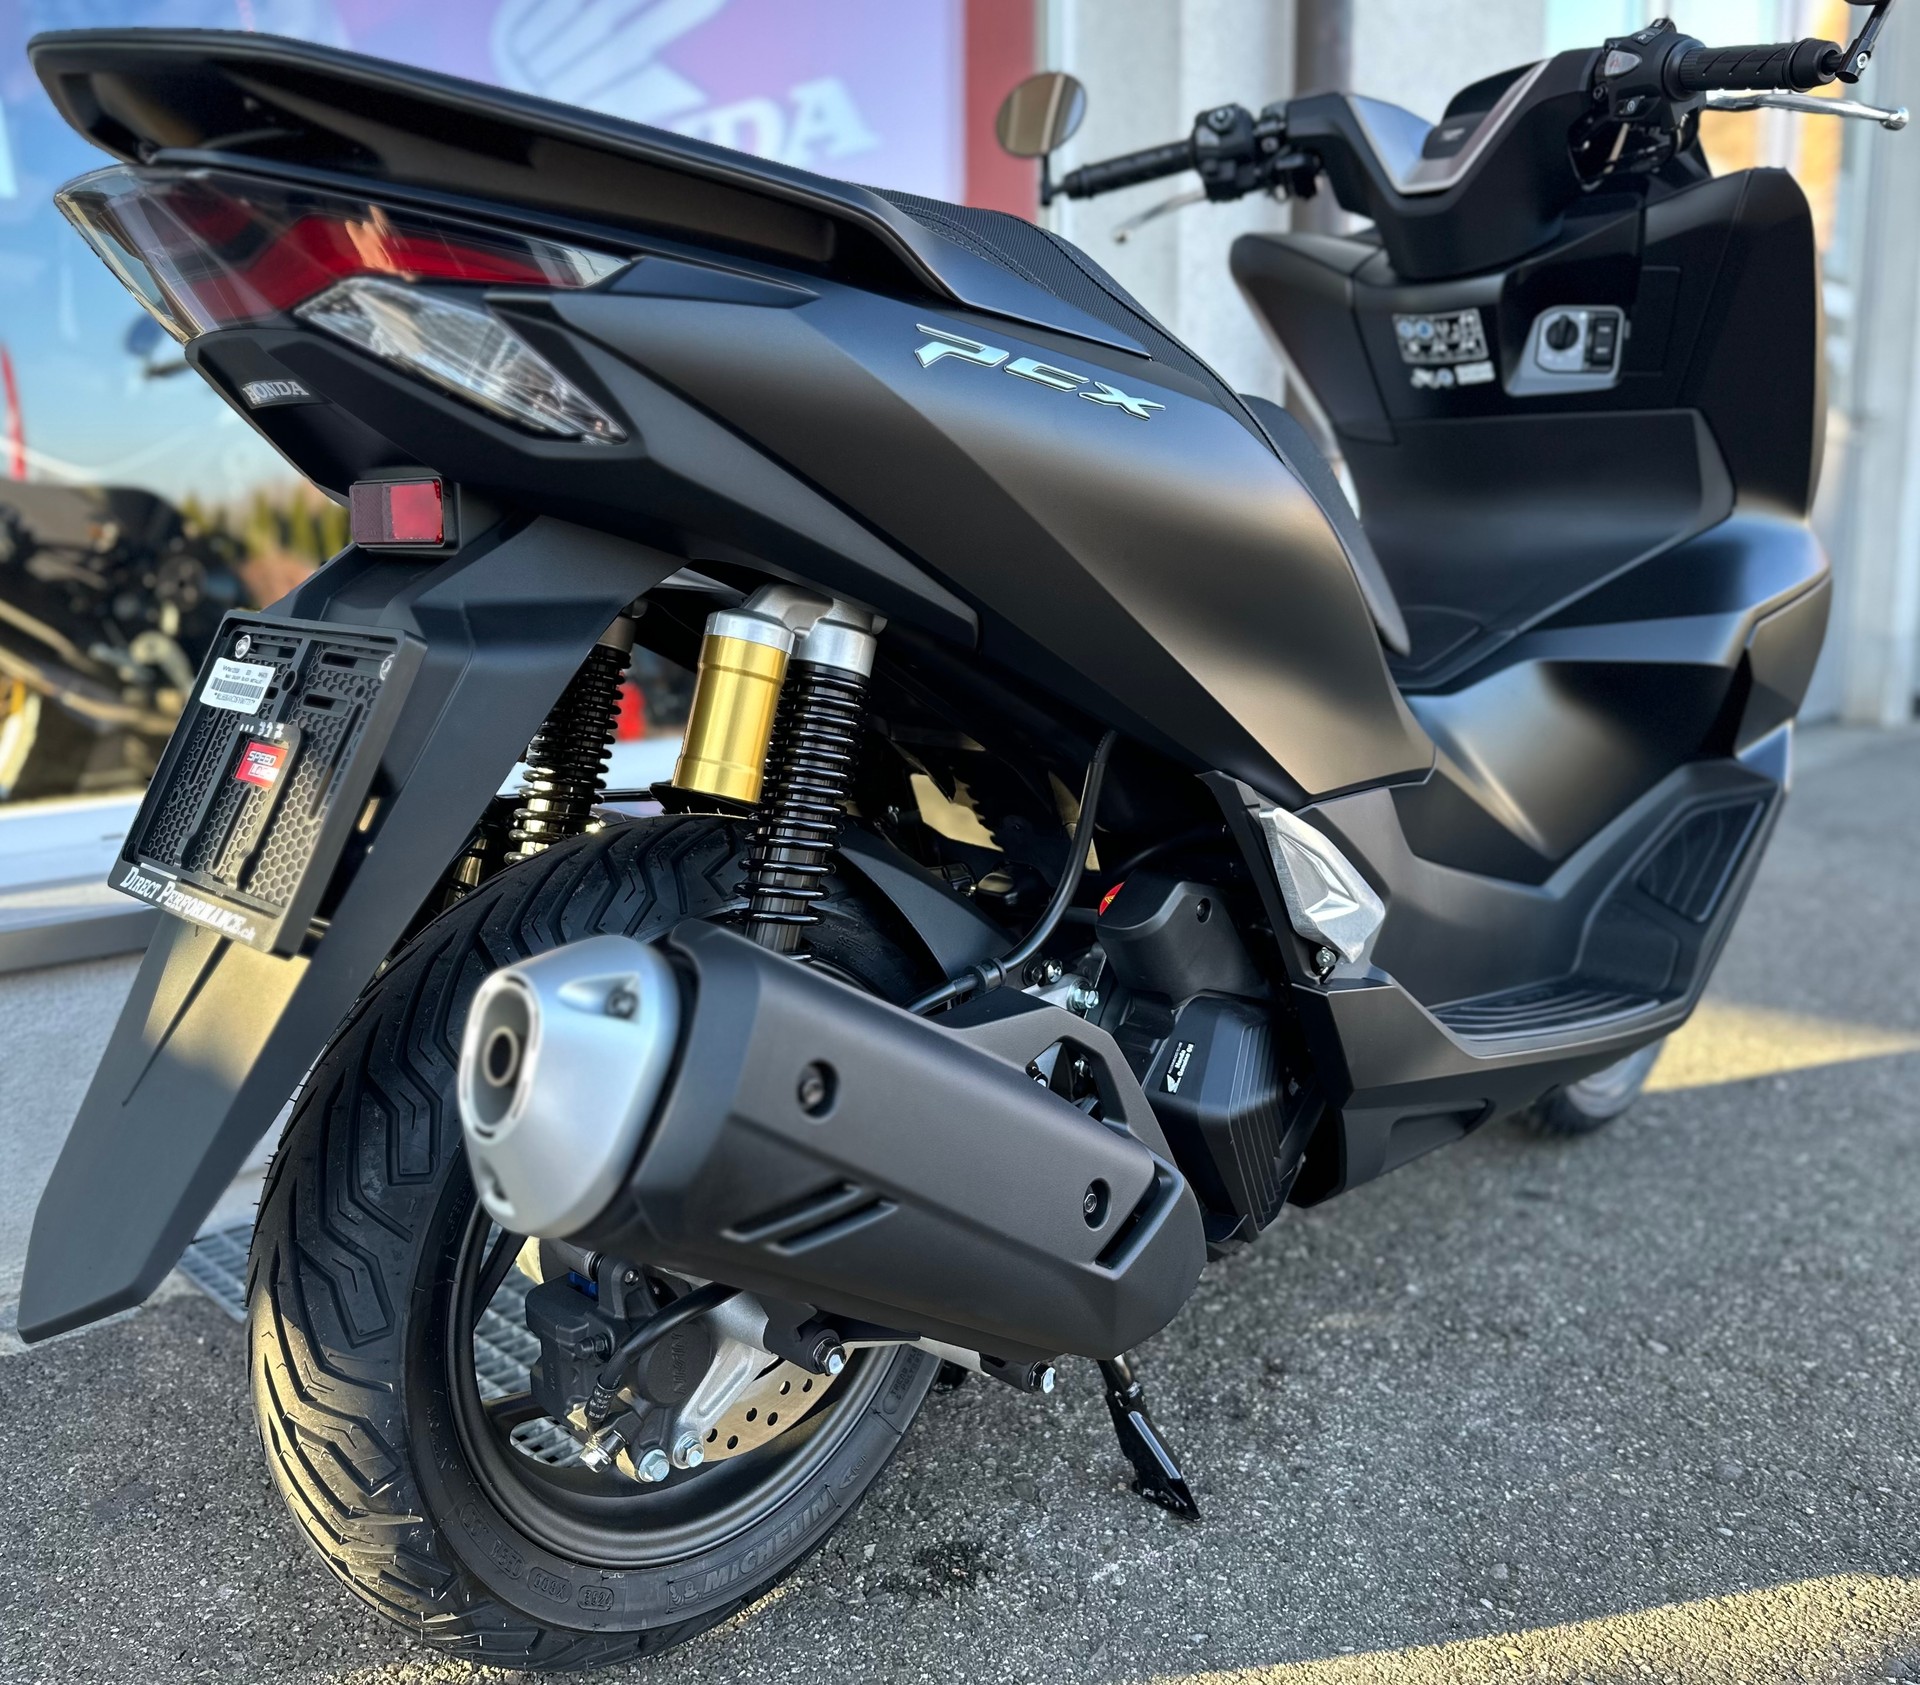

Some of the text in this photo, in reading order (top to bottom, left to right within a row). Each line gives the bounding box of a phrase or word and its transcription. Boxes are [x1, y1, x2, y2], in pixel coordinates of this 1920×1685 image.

[914, 323, 1166, 421] PCX
[242, 380, 310, 405] HONDA
[246, 750, 278, 767] SPEED
[120, 867, 163, 899] DIRECT
[702, 1491, 832, 1594] MICHELIN
